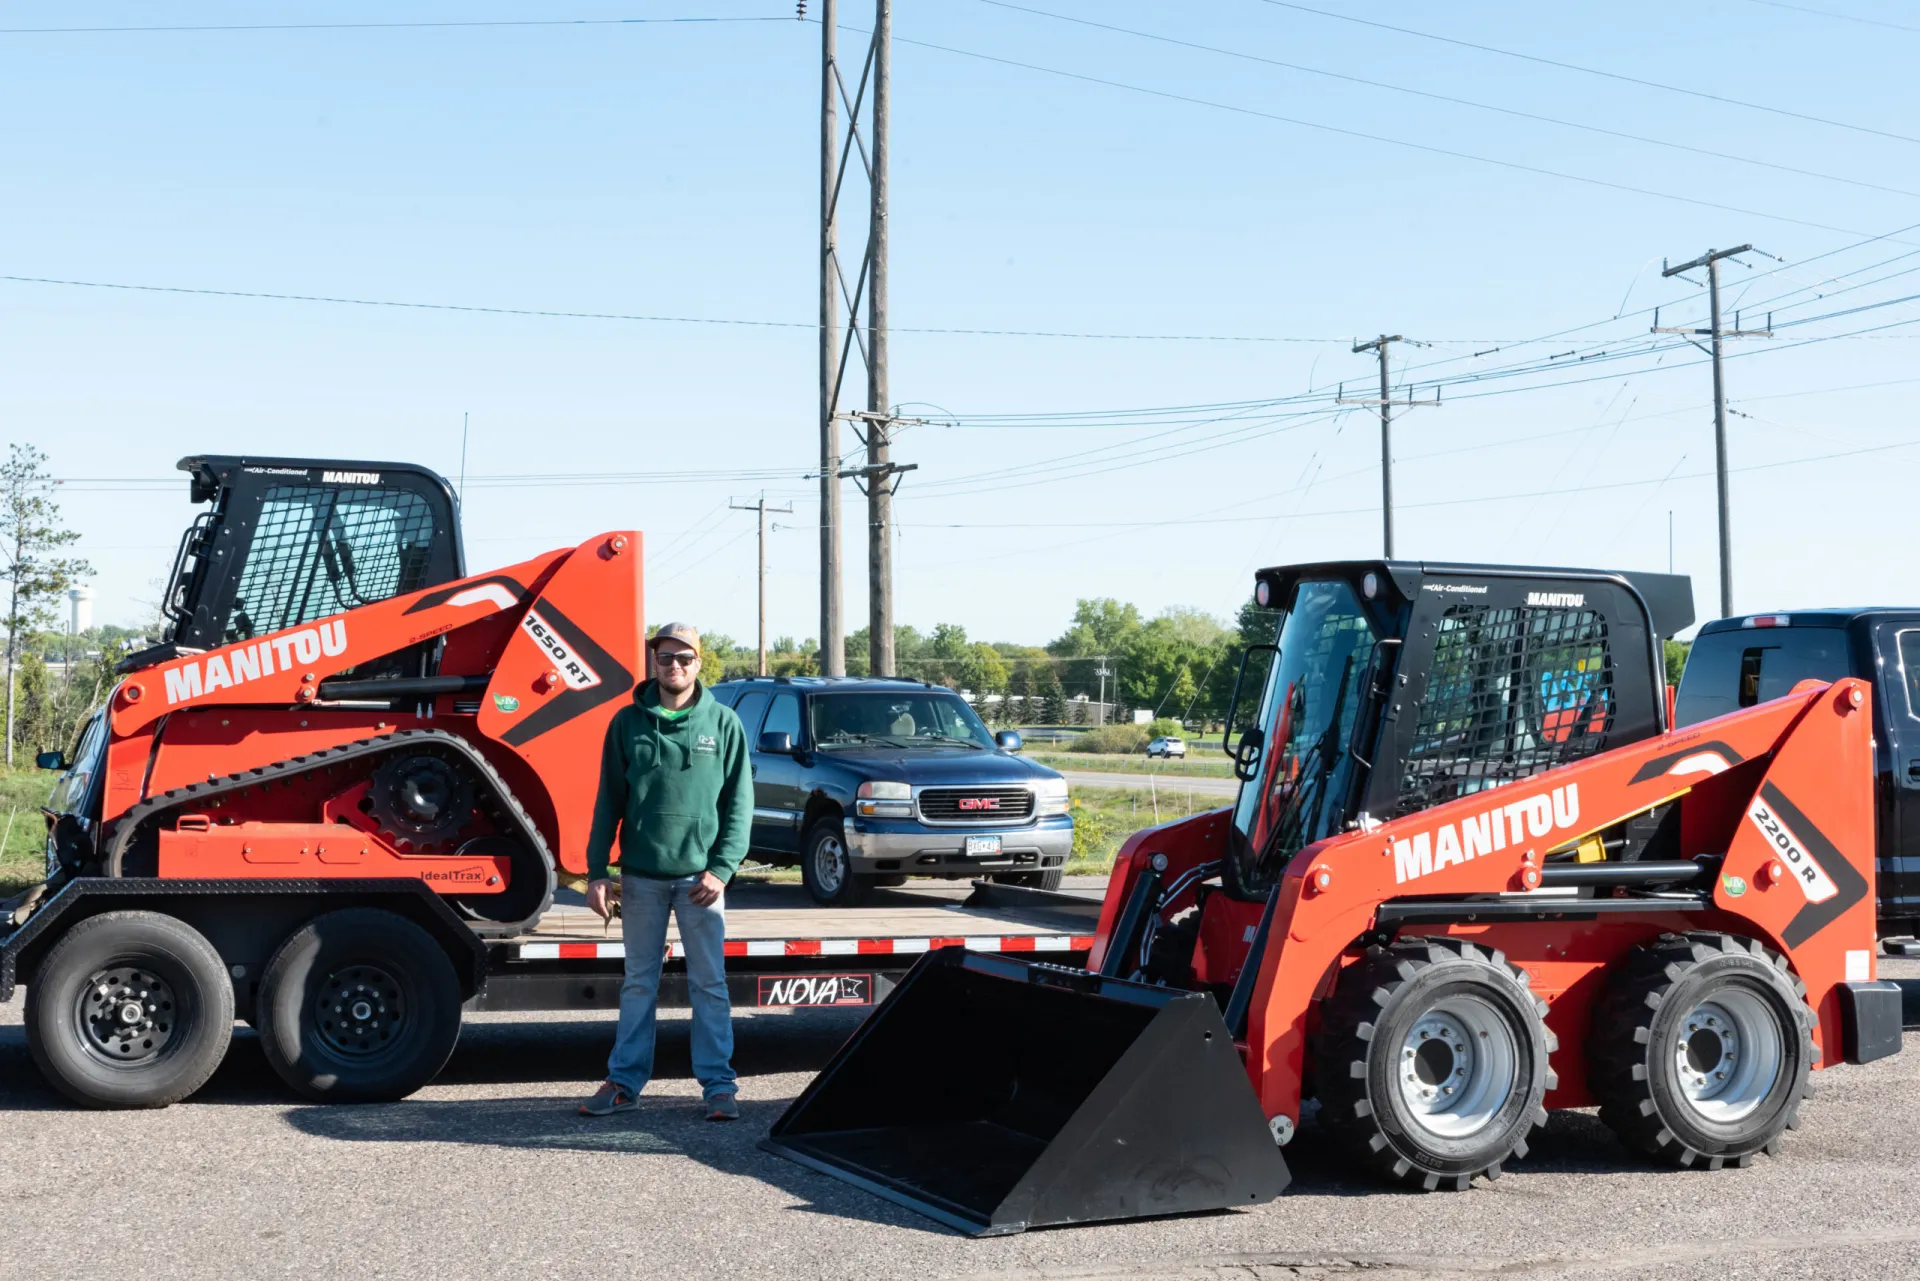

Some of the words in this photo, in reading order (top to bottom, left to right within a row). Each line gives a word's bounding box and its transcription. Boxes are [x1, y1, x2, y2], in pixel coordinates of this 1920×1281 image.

[322, 471, 380, 485] MANITOU
[1527, 592, 1584, 607] MANITOU
[163, 619, 348, 704] MANITOU
[525, 615, 567, 660] 1650
[565, 662, 591, 684] RT
[958, 798, 1000, 810] GMC
[1393, 783, 1580, 884] MANITOU
[1755, 808, 1801, 863] 2200
[1801, 866, 1816, 883] R
[420, 871, 481, 881] IdealTrax
[767, 977, 838, 1006] NOVA
